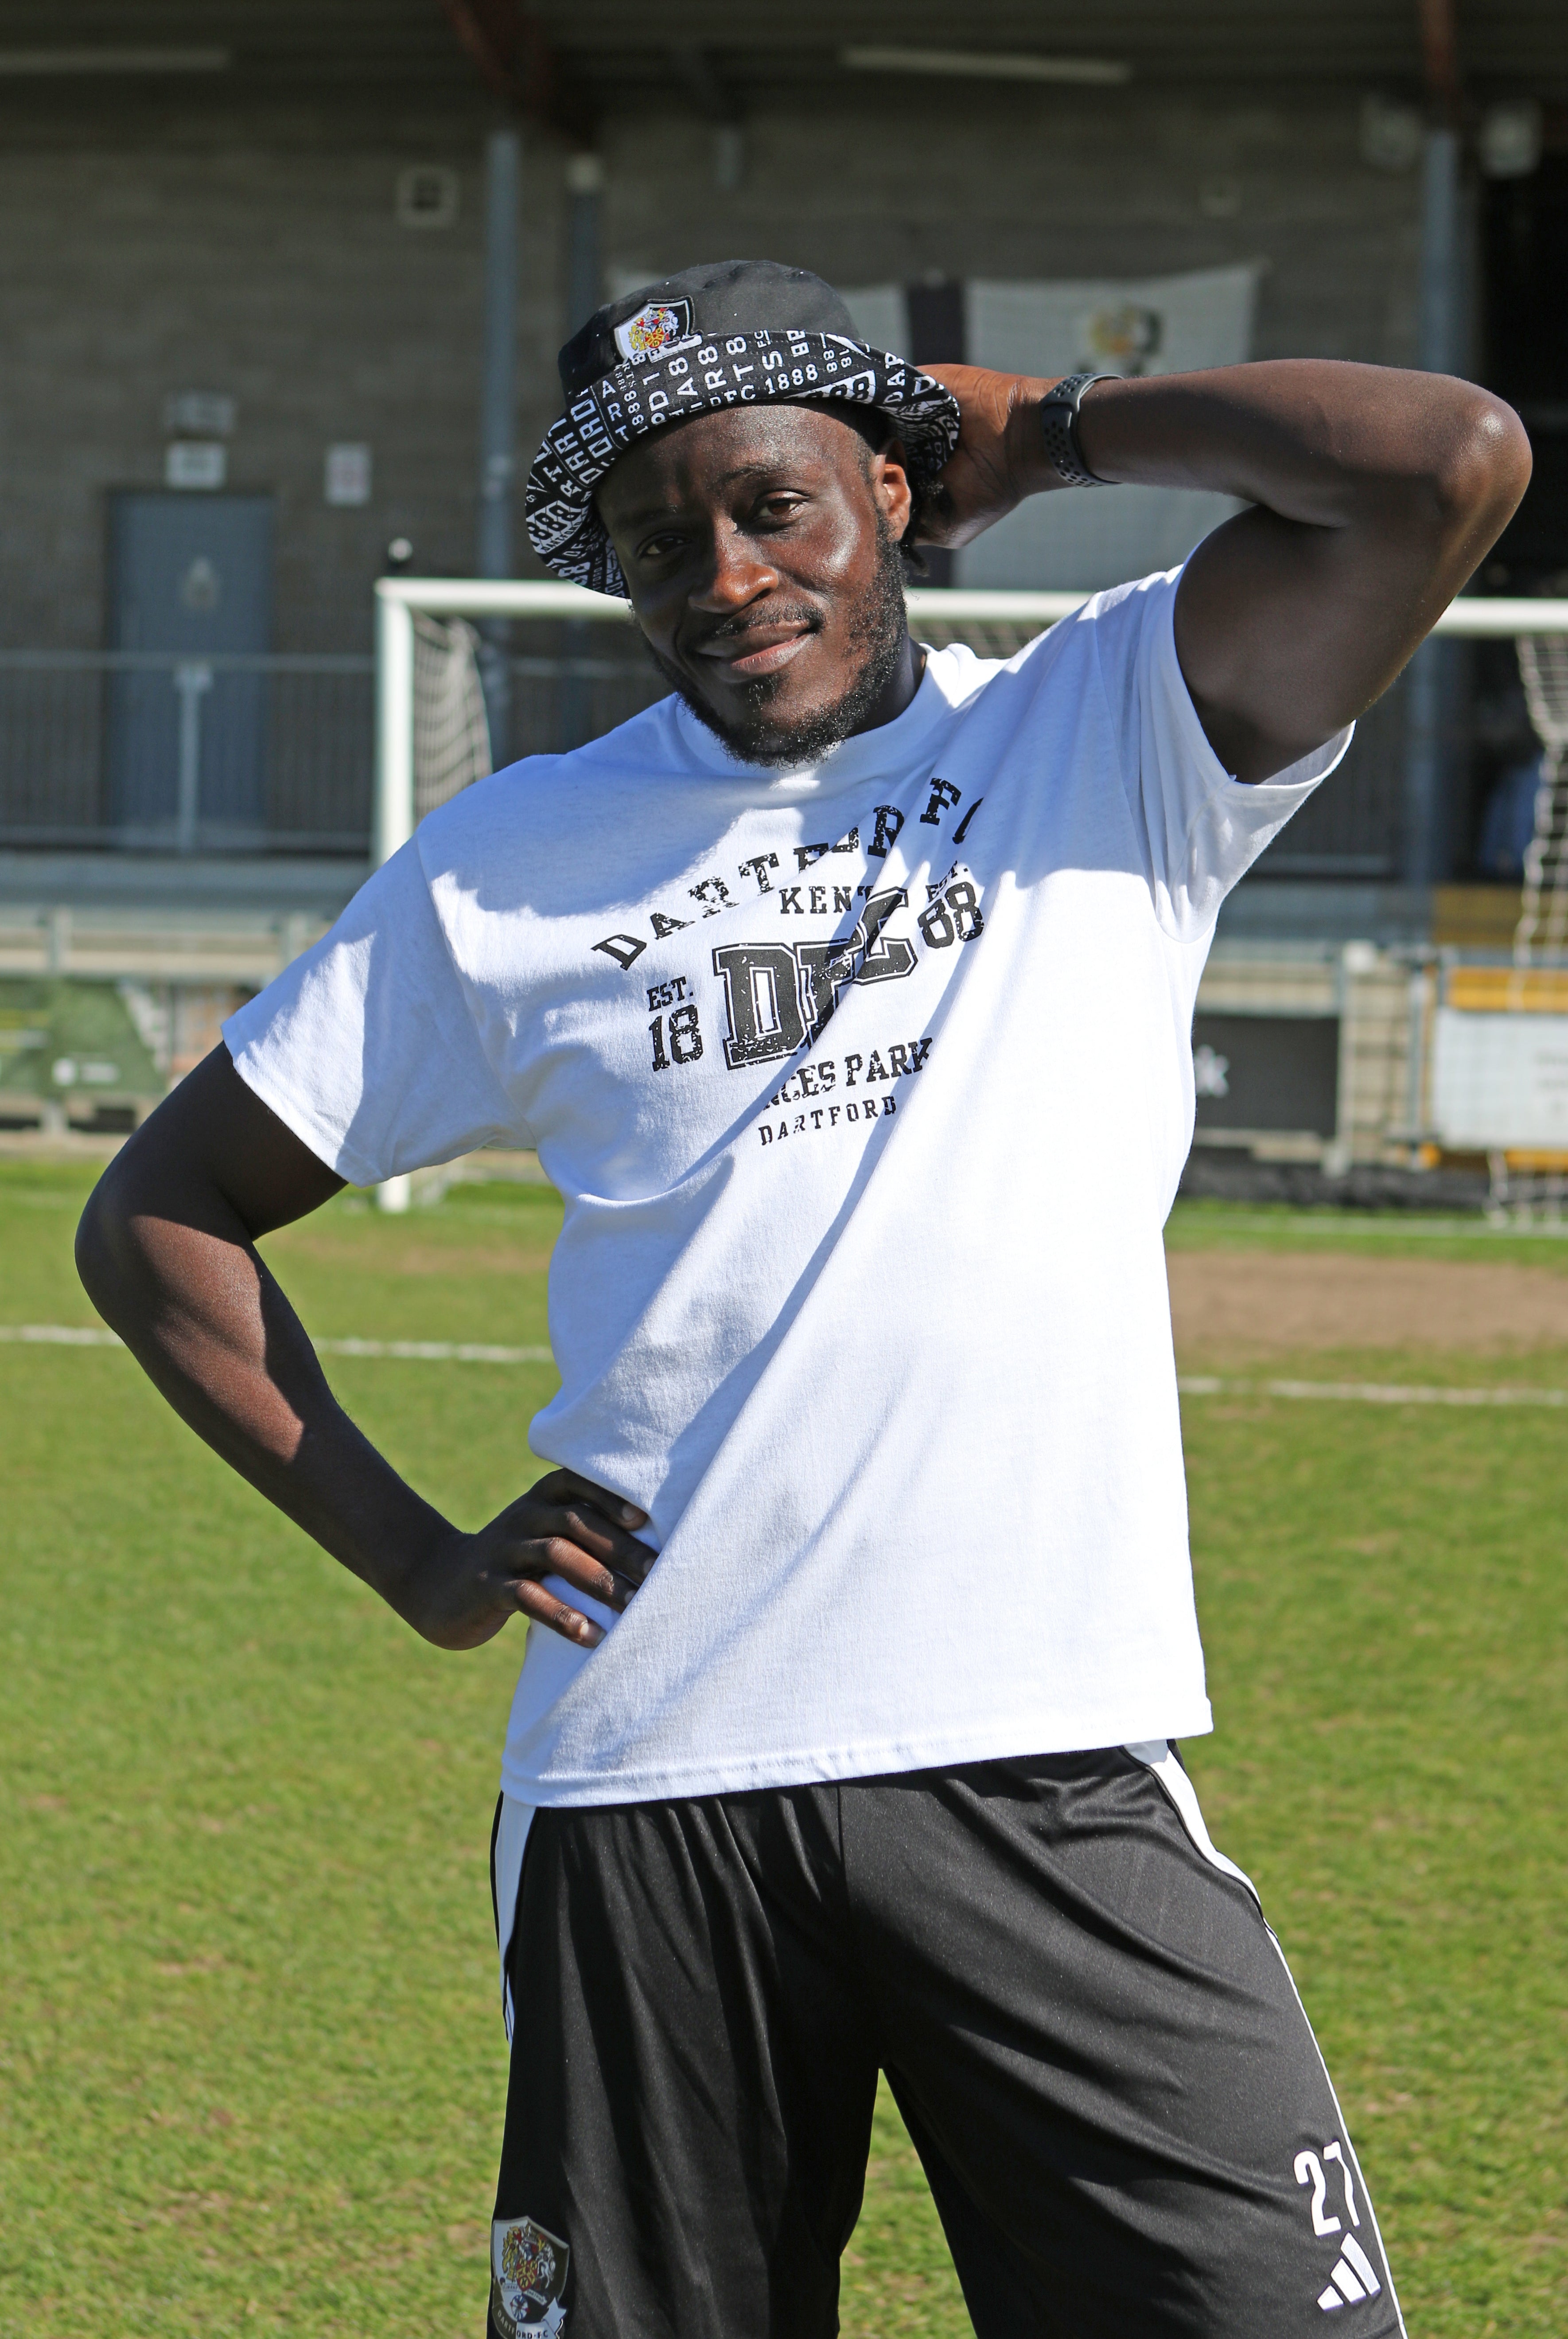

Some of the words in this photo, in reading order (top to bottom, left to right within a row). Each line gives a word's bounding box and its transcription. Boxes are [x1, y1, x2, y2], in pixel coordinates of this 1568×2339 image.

[764, 363, 819, 394] 1888
[570, 399, 616, 467] ORD
[591, 805, 905, 971] DARTFR
[918, 881, 984, 949] 88
[647, 976, 694, 1012] EST.
[648, 1005, 704, 1072] 18
[844, 1037, 933, 1087] PARK
[758, 1095, 897, 1146] DARTFORD
